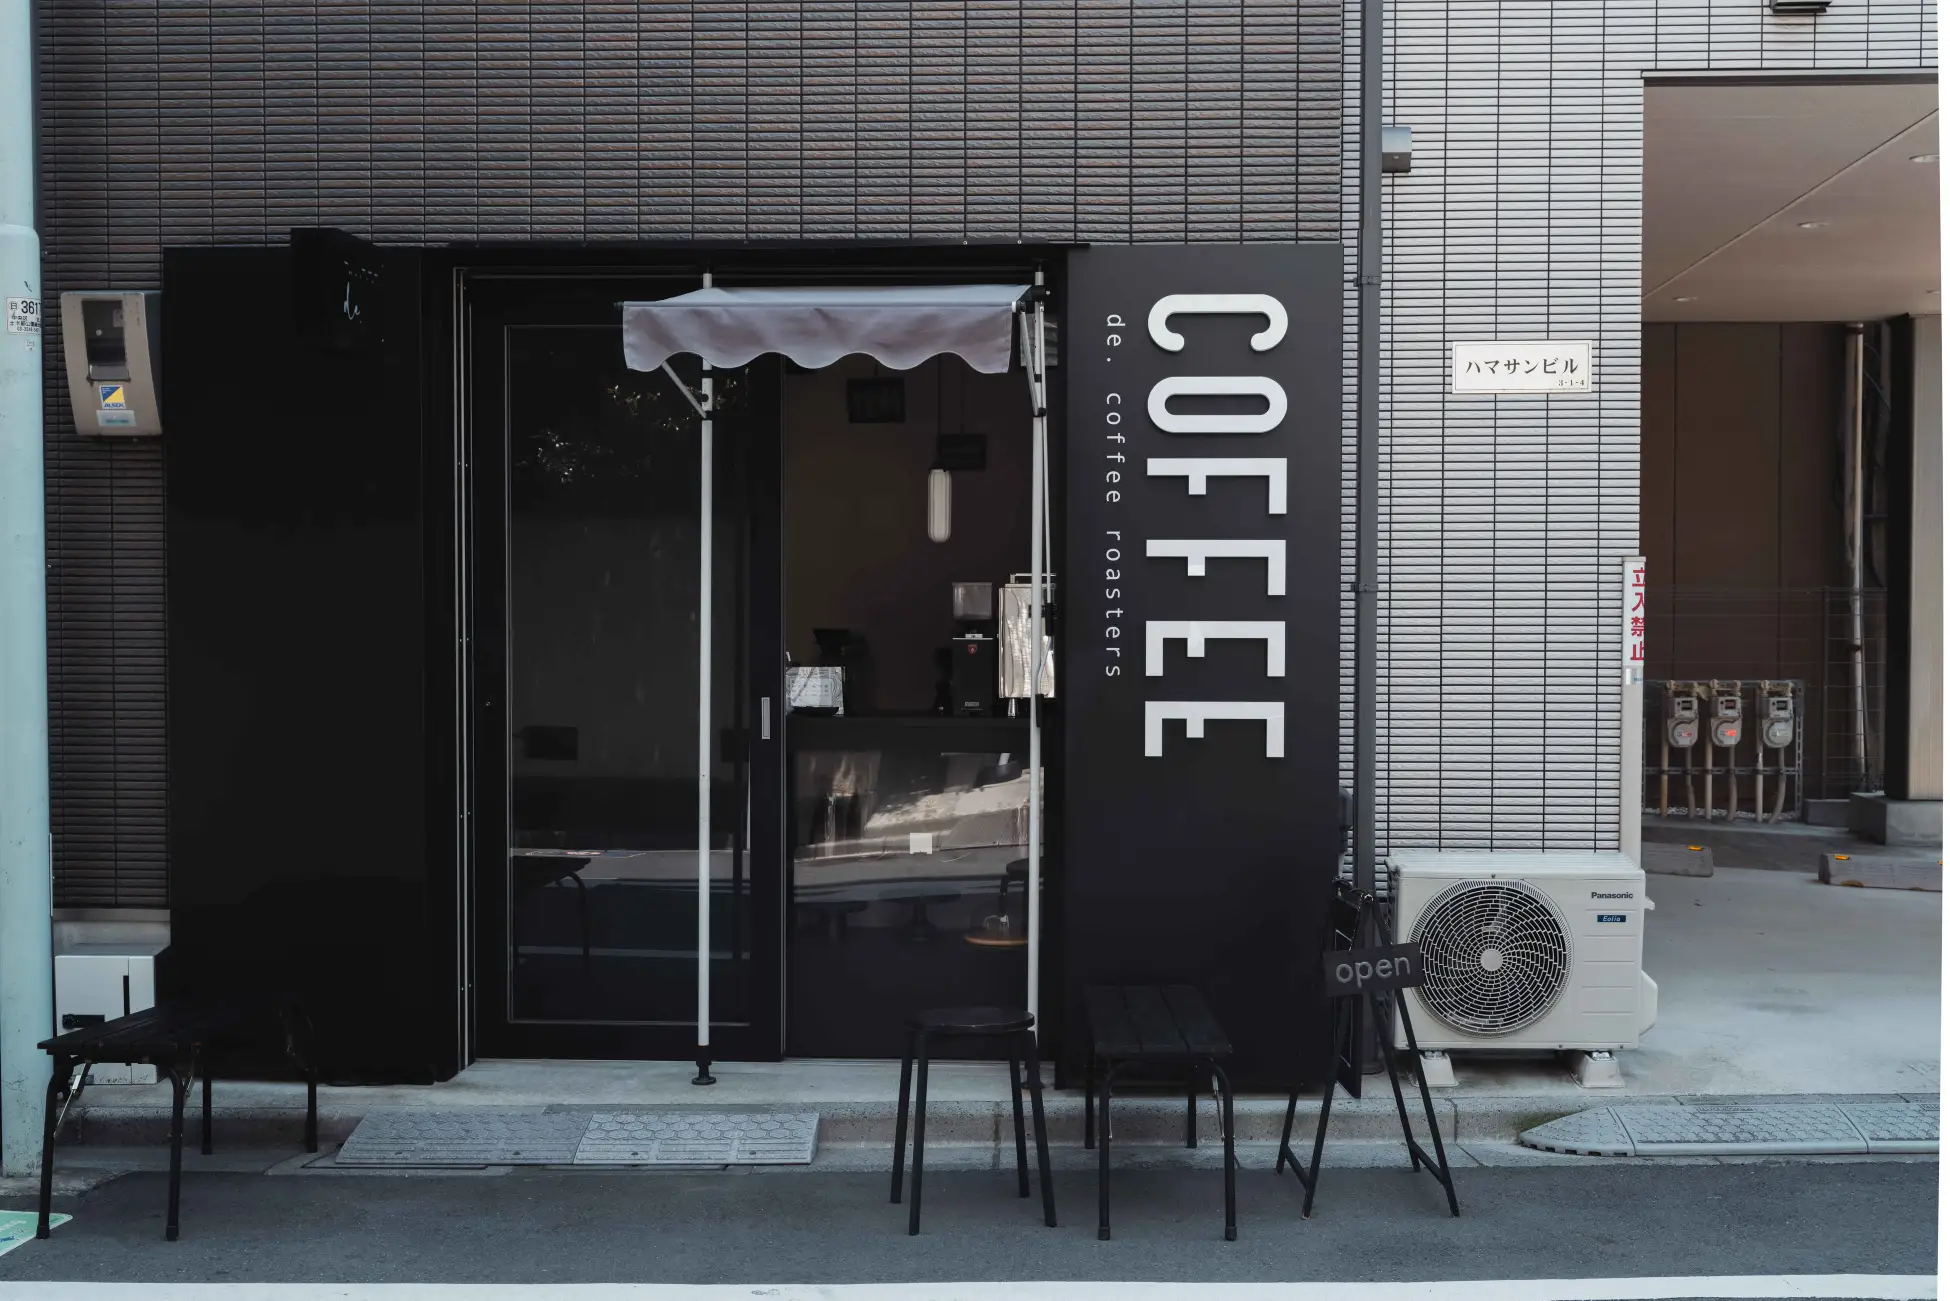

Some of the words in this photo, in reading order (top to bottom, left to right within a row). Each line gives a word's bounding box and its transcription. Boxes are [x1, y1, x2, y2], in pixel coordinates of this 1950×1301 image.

[21, 300, 41, 315] 361
[1106, 313, 1126, 363] de.
[1465, 357, 1579, 375] ハマサンビル
[1106, 392, 1126, 503] coffee
[1145, 294, 1288, 758] COFFEE
[1105, 531, 1124, 678] roasters
[1630, 567, 1645, 660] 立入禁止
[1335, 957, 1411, 989] open
